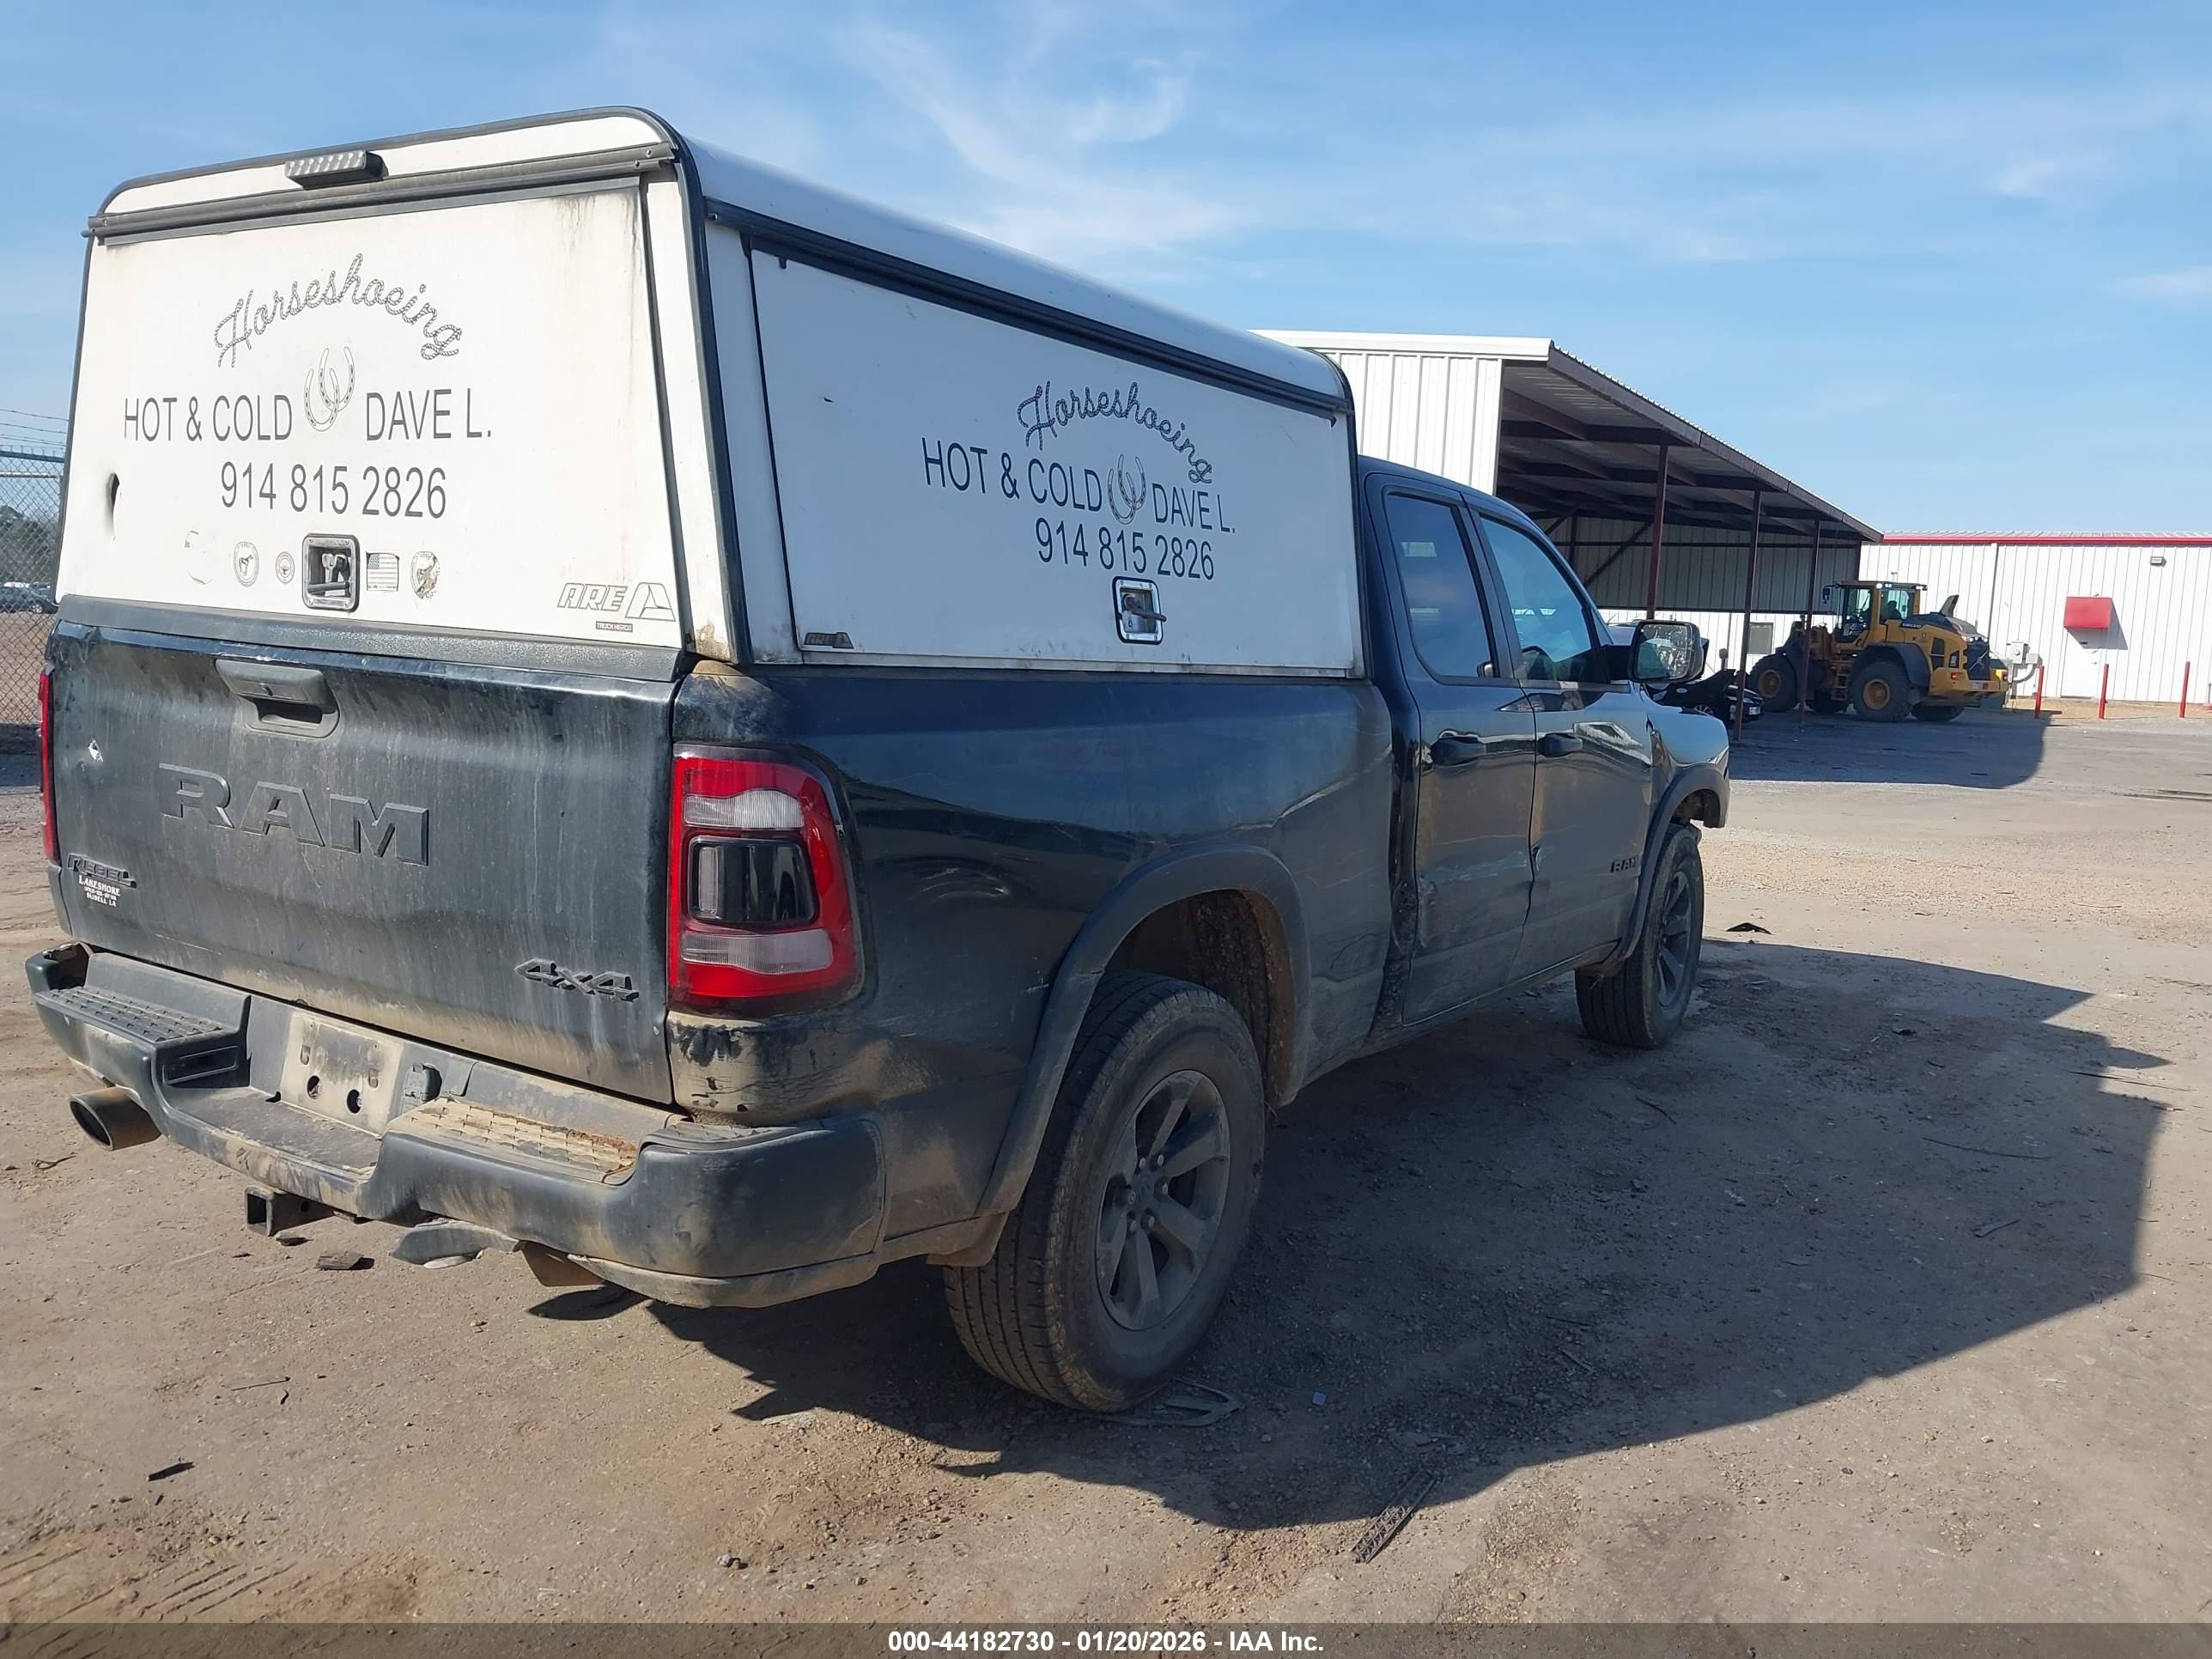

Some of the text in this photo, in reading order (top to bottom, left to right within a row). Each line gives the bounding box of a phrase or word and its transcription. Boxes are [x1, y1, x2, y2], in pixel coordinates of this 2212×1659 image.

[214, 252, 463, 368] Horseshoeing
[125, 388, 491, 441] HOT & COLD DAVE L.
[1017, 380, 1212, 484] Horseshoeing
[221, 461, 447, 518] 914 815 2826
[921, 437, 1236, 533] HOT & COLD DAVE L.
[1035, 517, 1214, 580] 914 815 2826
[557, 582, 628, 612] ARE
[158, 763, 429, 866] RAM
[68, 853, 137, 889] REBEL
[78, 874, 121, 896] LAKESHORE
